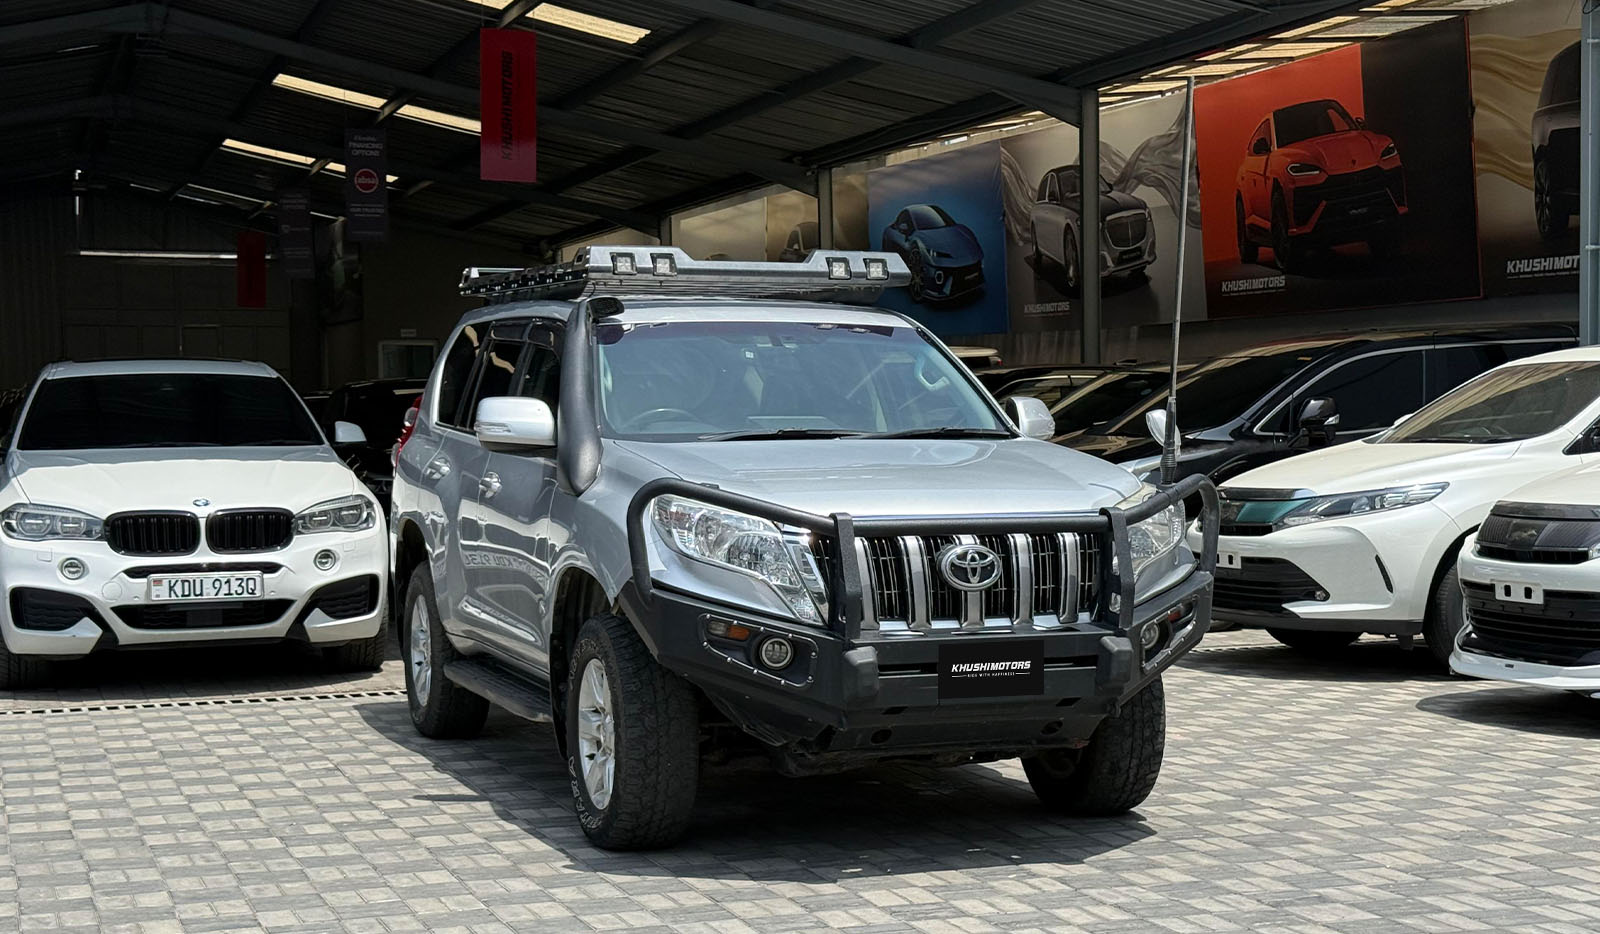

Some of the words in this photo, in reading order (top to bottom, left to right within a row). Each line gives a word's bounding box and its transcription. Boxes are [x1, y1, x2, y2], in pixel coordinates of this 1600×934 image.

[1506, 255, 1580, 274] KHUSHIMOT
[1221, 275, 1286, 293] KHUSHIMOTORS
[168, 579, 204, 598] KDU
[212, 577, 257, 597] 913Q
[951, 660, 1031, 672] KHUSHIMOTORS
